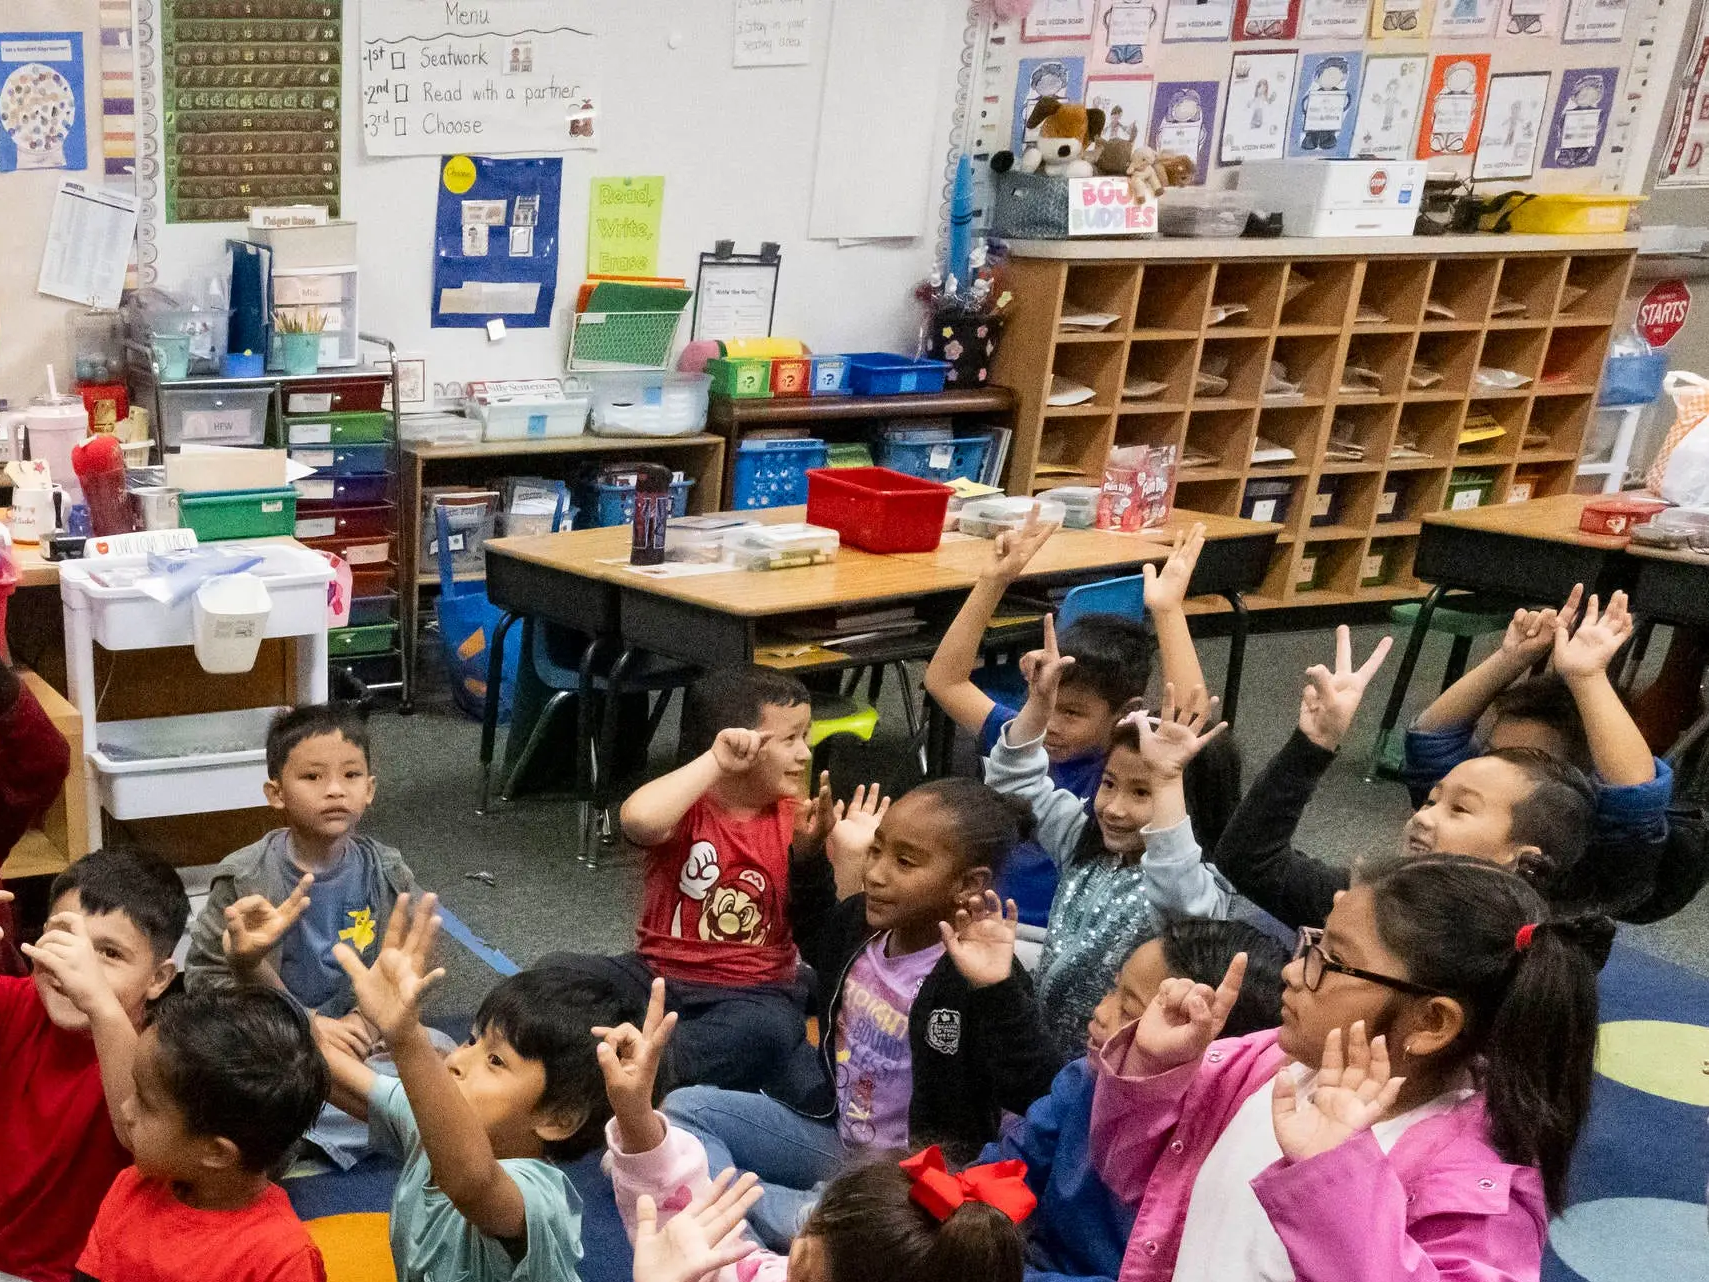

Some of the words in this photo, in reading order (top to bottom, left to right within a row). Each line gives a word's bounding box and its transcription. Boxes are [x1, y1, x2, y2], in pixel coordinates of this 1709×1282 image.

[445, 1, 491, 25] Menu
[420, 44, 489, 69] Seatwork
[367, 79, 389, 104] 2nd
[423, 81, 462, 102] Read
[473, 82, 498, 100] with
[505, 88, 515, 99] a
[525, 75, 581, 107] partner
[242, 119, 252, 127] 55
[324, 120, 333, 129] 60
[369, 110, 389, 137] 3rd
[422, 112, 484, 134] Choose
[325, 140, 334, 149] 70
[323, 161, 332, 171] 80
[600, 185, 655, 208] Read,
[596, 217, 654, 241] Write,
[1071, 206, 1156, 230] BUDDIES
[599, 252, 649, 273] Erase
[1641, 301, 1687, 327] STARTS
[1104, 482, 1118, 492] Fun
[1119, 482, 1133, 495] Dip
[1141, 480, 1156, 499] Fun
[1156, 477, 1168, 496] Dip
